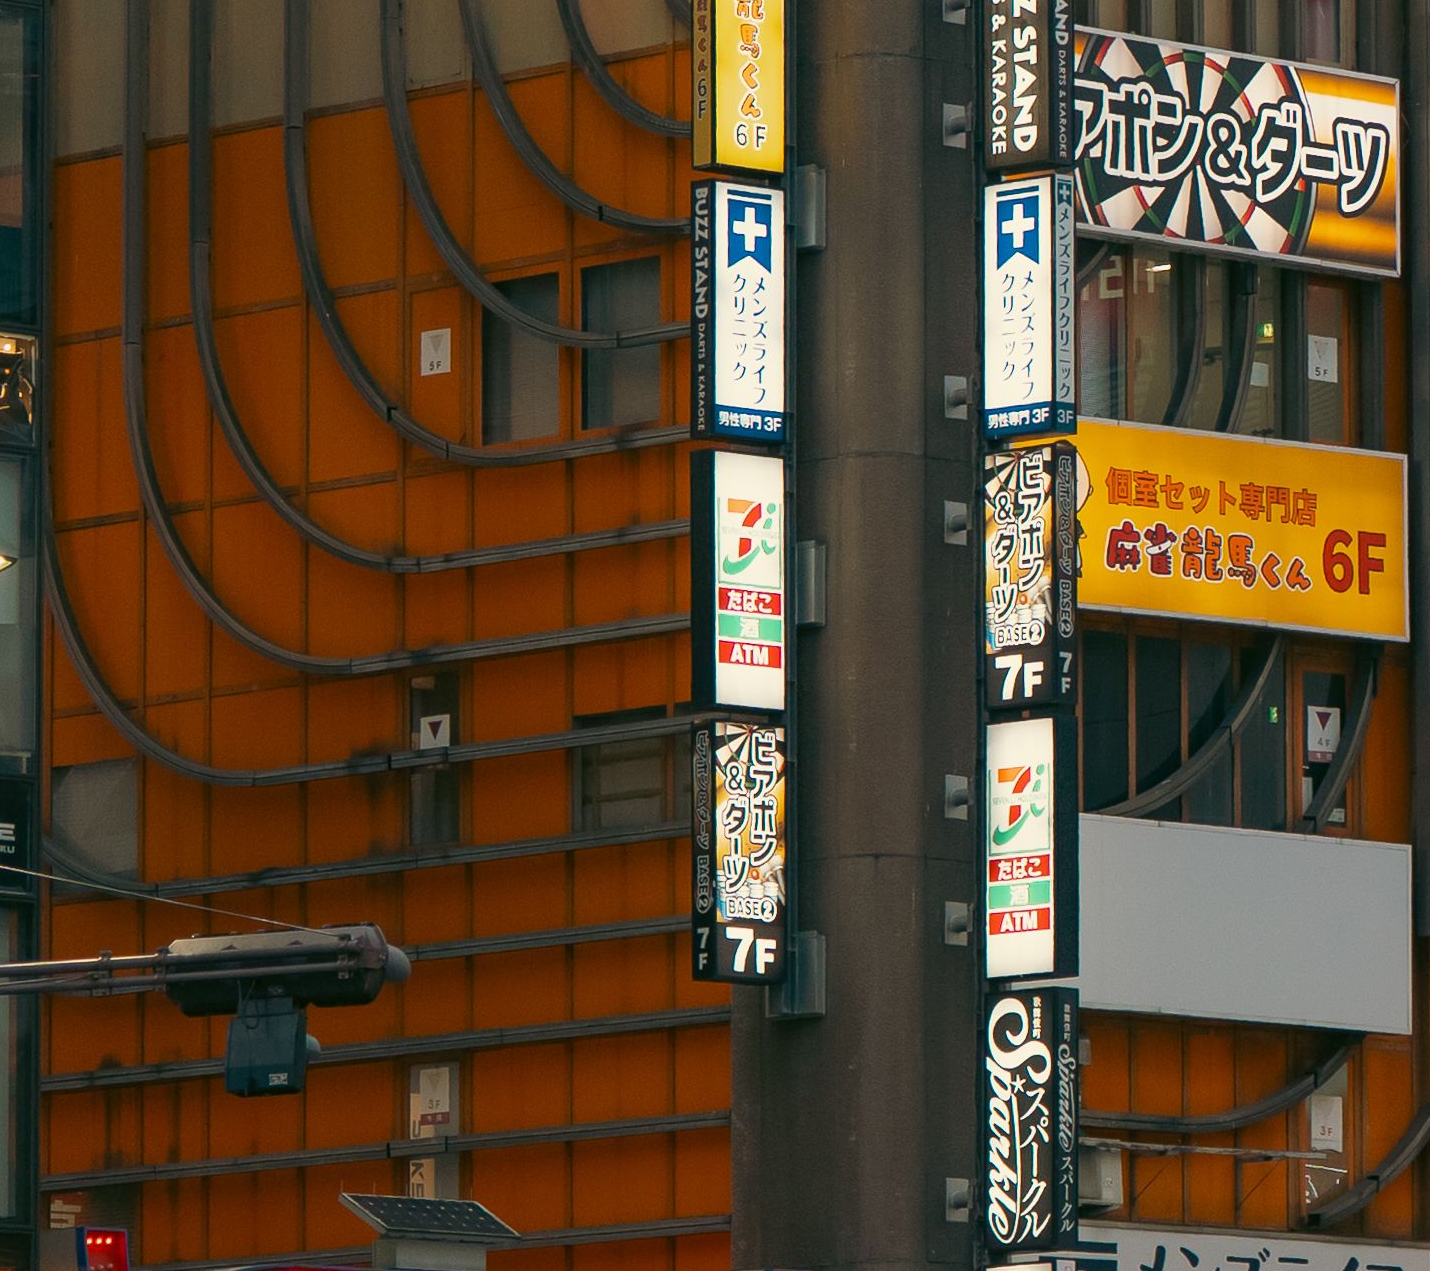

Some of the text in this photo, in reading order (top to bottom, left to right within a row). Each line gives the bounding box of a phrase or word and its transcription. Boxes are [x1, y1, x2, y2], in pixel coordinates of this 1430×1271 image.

[991, 37, 1007, 156] KARAOKE
[1012, 24, 1038, 153] STAND
[1058, 50, 1066, 87] DARTS
[735, 124, 767, 150] 6F
[1059, 102, 1068, 159] KARAOKE
[696, 186, 709, 432] BUZZ STAND DARTS KARAOKE
[734, 273, 748, 382] クリニック
[1002, 274, 1016, 380] クリニック
[1058, 206, 1071, 401] メンズライフクリニック
[753, 276, 767, 405] メンズライフ
[1022, 271, 1035, 400] メンズライフ
[718, 411, 782, 432] 男性専門 3F
[988, 408, 1049, 430] 男性専門 3F
[1057, 408, 1073, 424] 3F
[1018, 454, 1045, 593] ビアポン
[1106, 467, 1317, 527] 個室セット専門店
[1105, 521, 1314, 591] 麻雀龍馬くん
[1322, 528, 1386, 596] 6F
[727, 591, 773, 613] たばこ
[739, 618, 760, 638] 酒
[730, 644, 768, 666] ATM
[995, 654, 1044, 699] 7F
[1059, 653, 1071, 694] 7F
[750, 732, 777, 867] ビアポン
[996, 857, 1043, 879] たばこ
[1009, 885, 1029, 906] 酒
[999, 912, 1038, 933] ATM
[725, 929, 776, 975] 7F
[1060, 1156, 1074, 1233] スパークル
